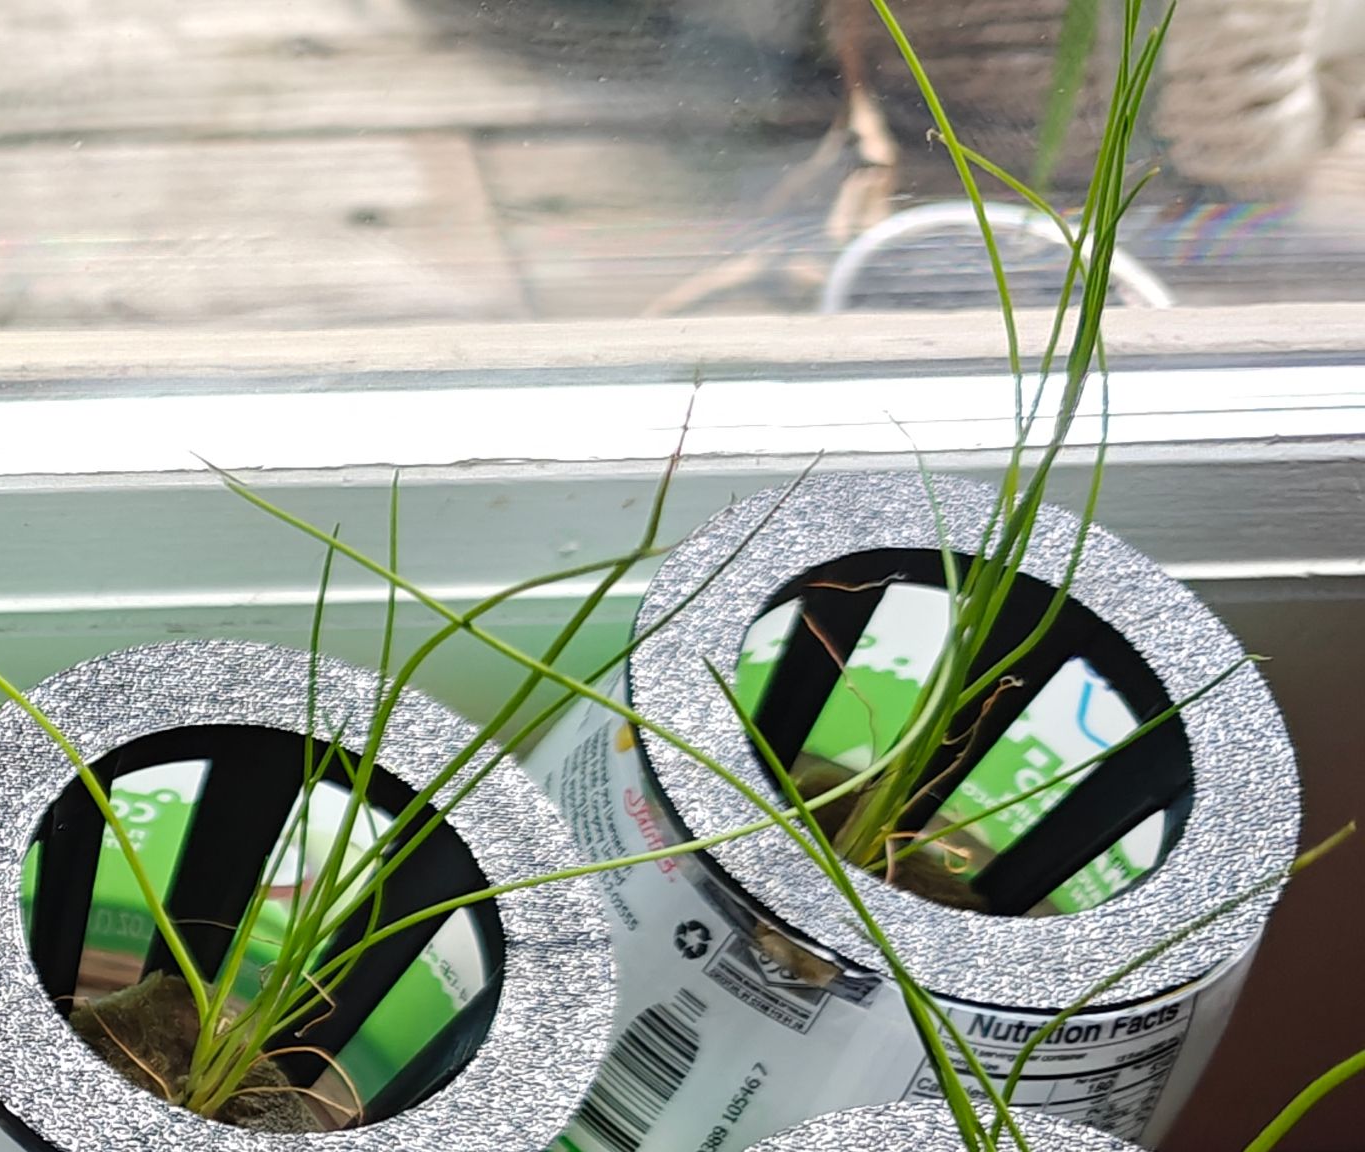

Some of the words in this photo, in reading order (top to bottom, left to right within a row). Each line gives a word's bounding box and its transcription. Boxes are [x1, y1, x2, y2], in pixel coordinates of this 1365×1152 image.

[1109, 1002, 1180, 1038] Facts
[722, 1076, 761, 1123] 10546
[752, 1062, 767, 1076] 7
